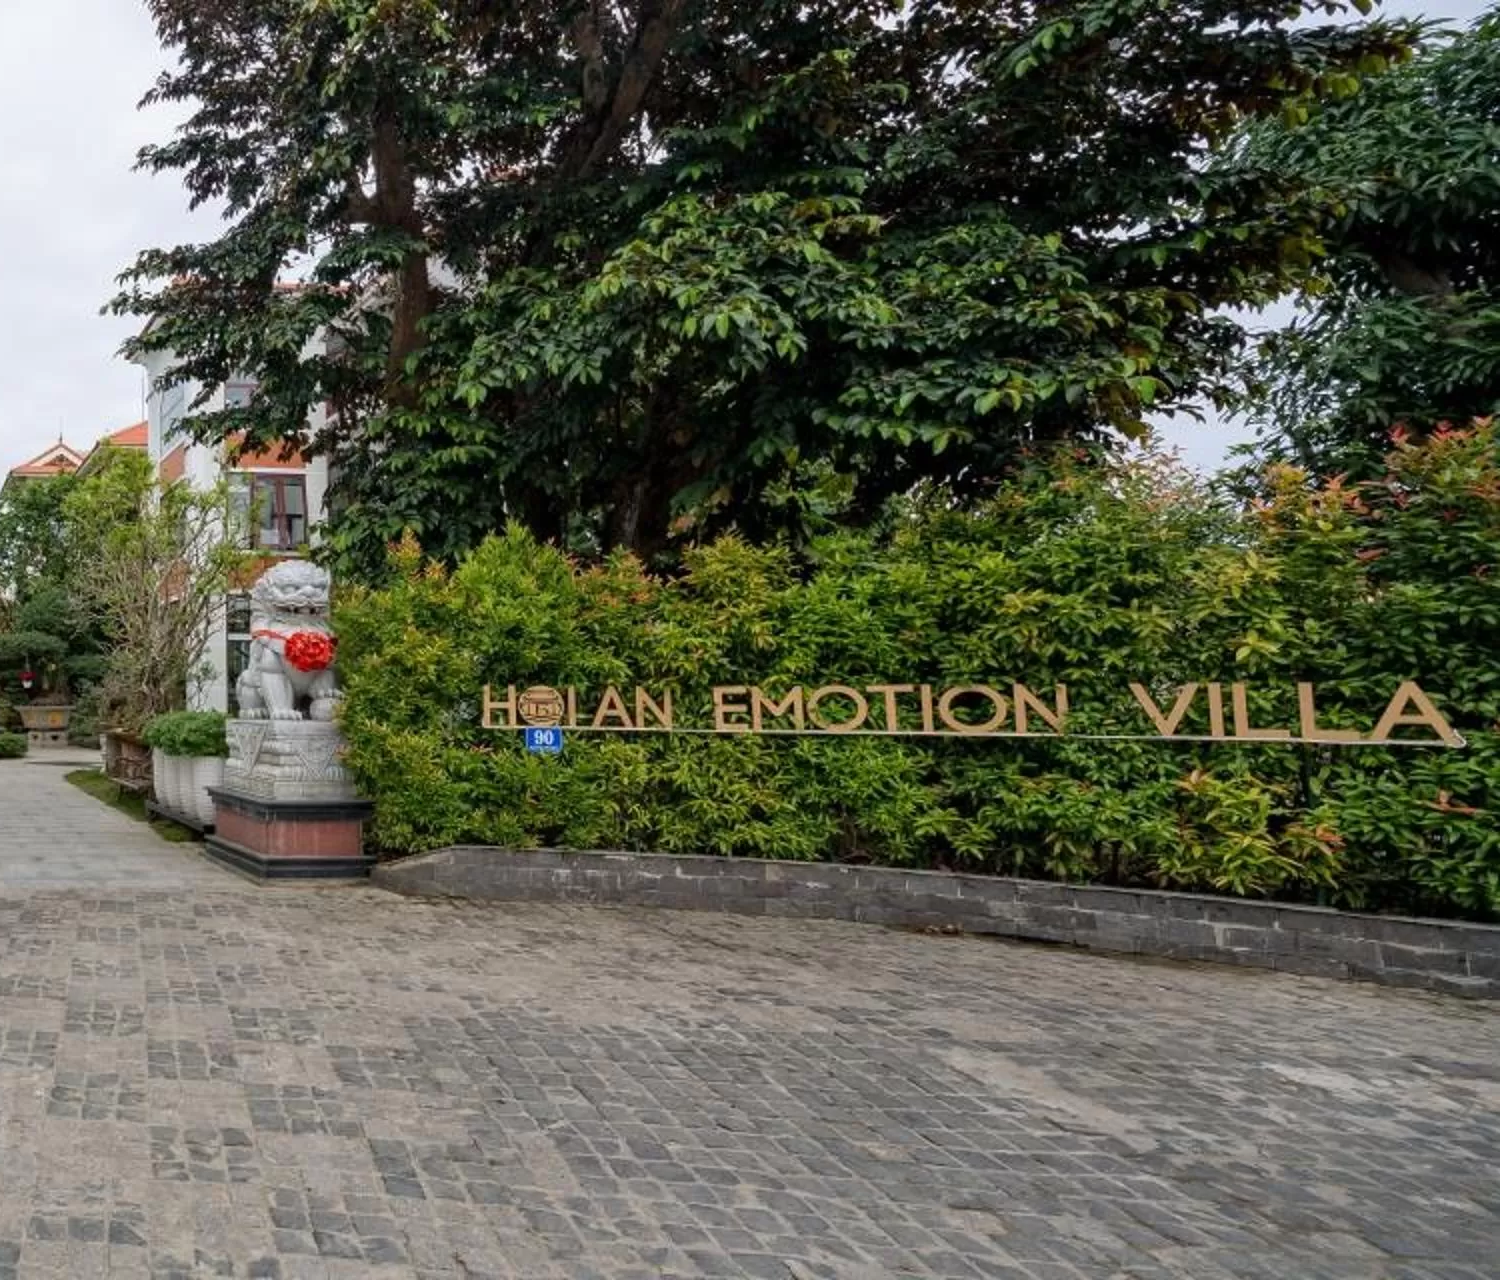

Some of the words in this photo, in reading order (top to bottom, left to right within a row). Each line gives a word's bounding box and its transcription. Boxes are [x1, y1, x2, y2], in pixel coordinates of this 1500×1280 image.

[712, 683, 1069, 735] EMOTION
[1128, 681, 1466, 746] VILLA
[533, 730, 555, 746] 90
